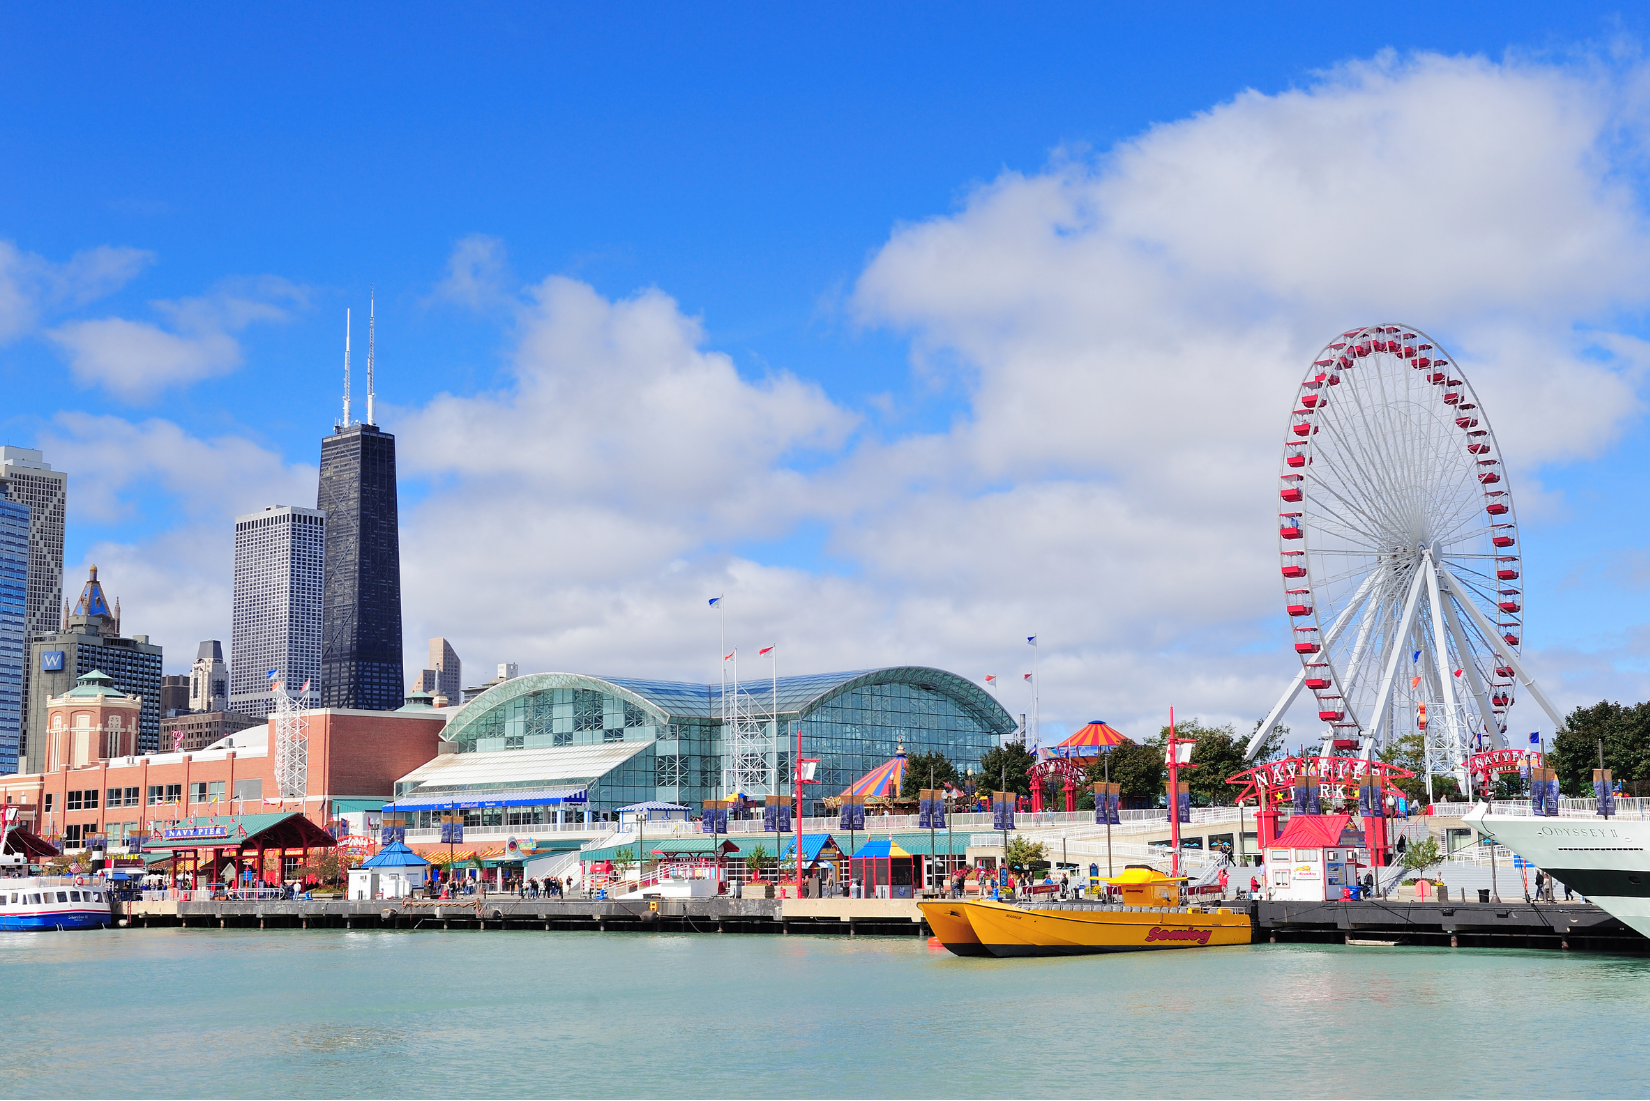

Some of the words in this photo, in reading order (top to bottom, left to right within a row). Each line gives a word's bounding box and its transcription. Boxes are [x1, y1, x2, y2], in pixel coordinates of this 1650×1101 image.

[44, 654, 61, 667] W
[1474, 751, 1511, 769] NAVY
[1254, 762, 1316, 788] NAVY
[168, 828, 195, 837] NAVY
[198, 827, 221, 836] PIER
[1541, 826, 1606, 838] ODYSSEY
[1610, 829, 1619, 838] II
[1144, 926, 1213, 945] Seadog
